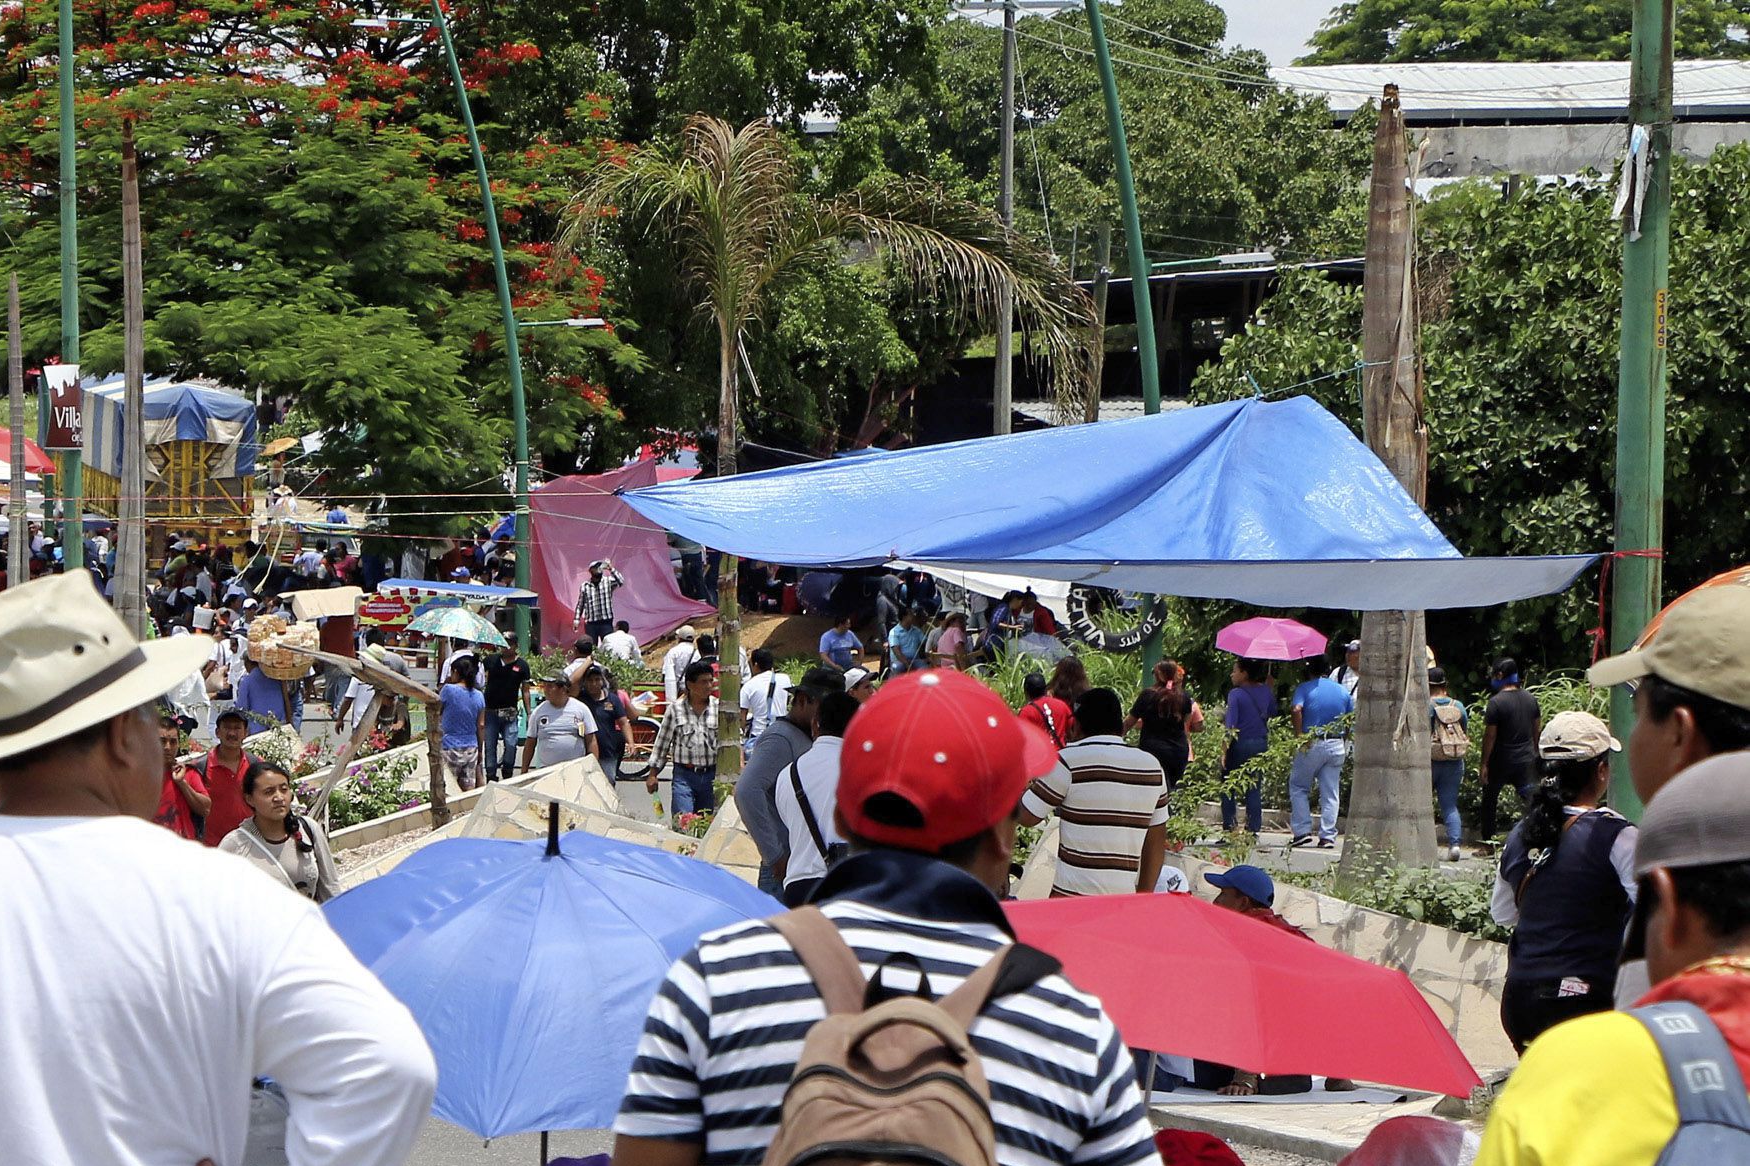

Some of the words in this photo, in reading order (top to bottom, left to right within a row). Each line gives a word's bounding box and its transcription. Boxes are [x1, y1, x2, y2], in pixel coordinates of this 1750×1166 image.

[1657, 292, 1666, 347] 31049
[1142, 611, 1162, 634] 30
[1119, 631, 1141, 648] MTS
